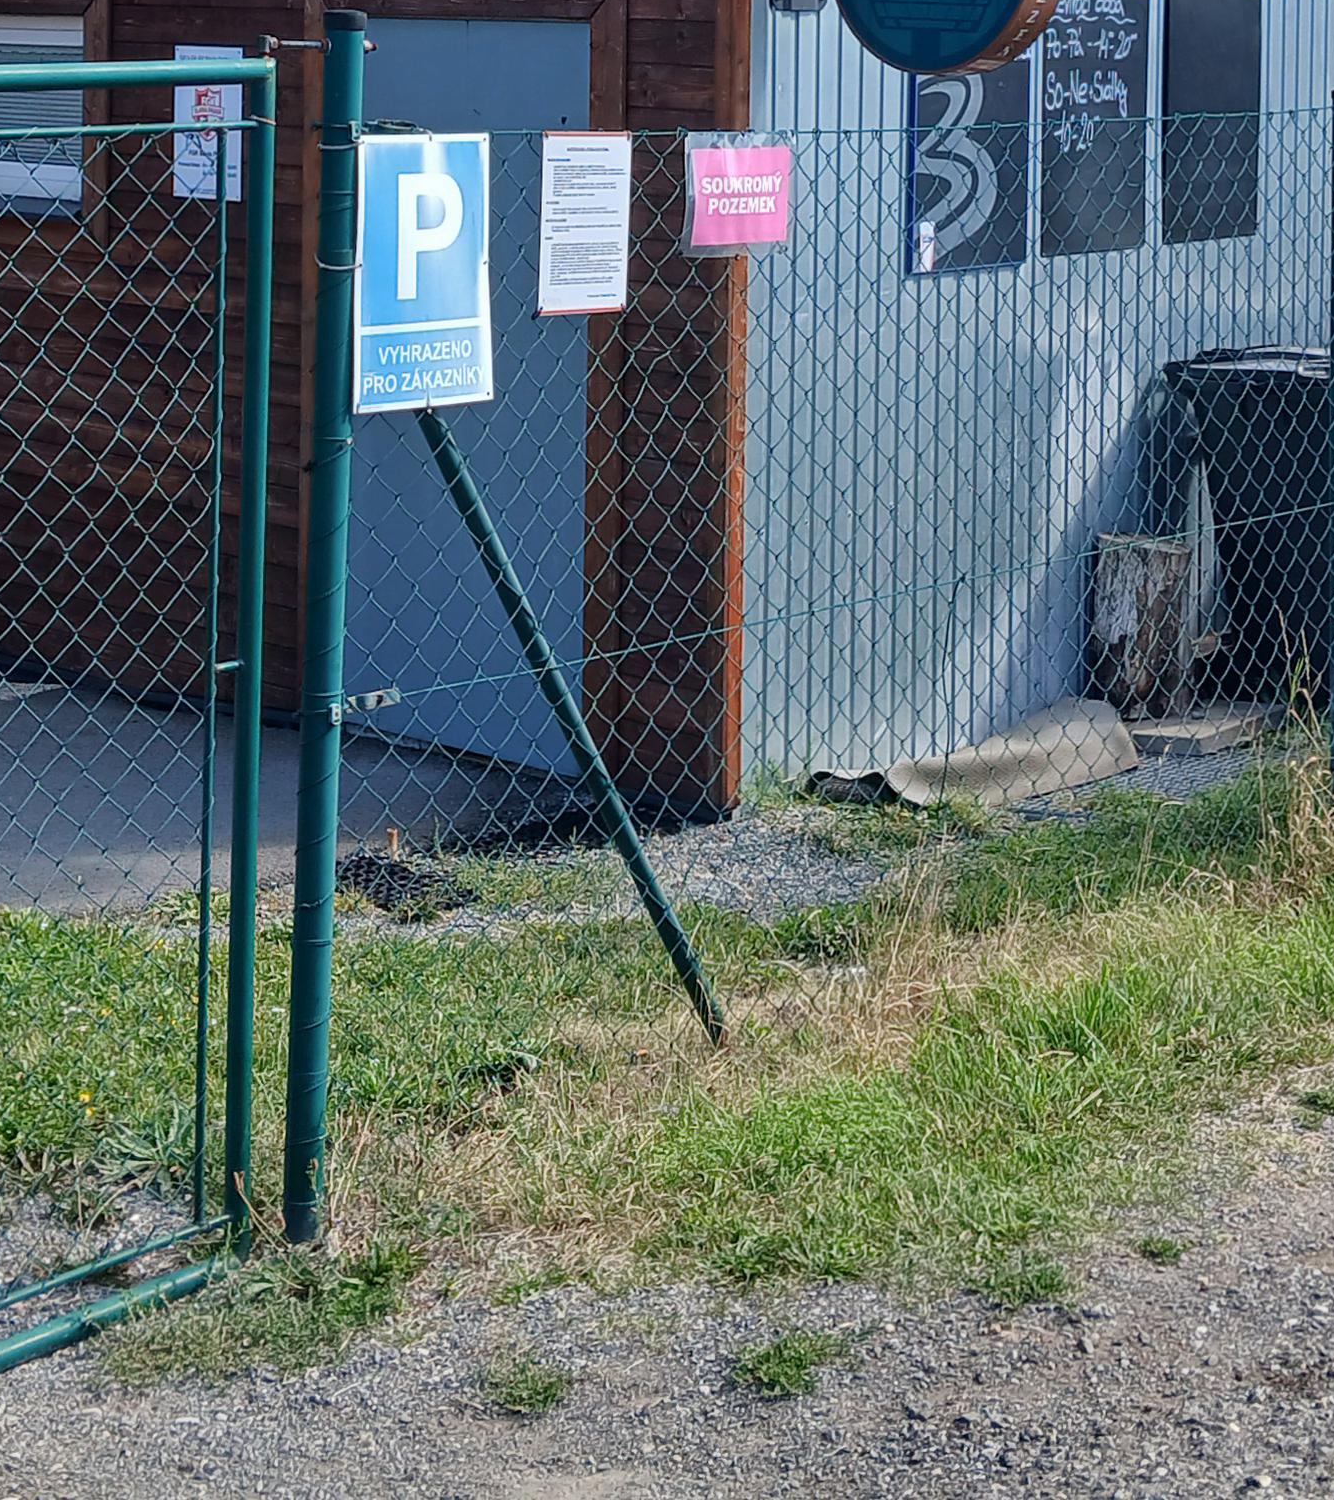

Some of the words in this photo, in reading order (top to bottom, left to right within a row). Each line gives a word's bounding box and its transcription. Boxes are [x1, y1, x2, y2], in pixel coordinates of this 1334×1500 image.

[700, 171, 783, 195] SOUKROMÝ
[707, 196, 777, 216] POZEMEK
[397, 173, 464, 301] P
[378, 339, 473, 366] VYHRAZENO
[362, 373, 398, 397] PRO
[400, 363, 486, 392] ZÁKAZNÍKY
